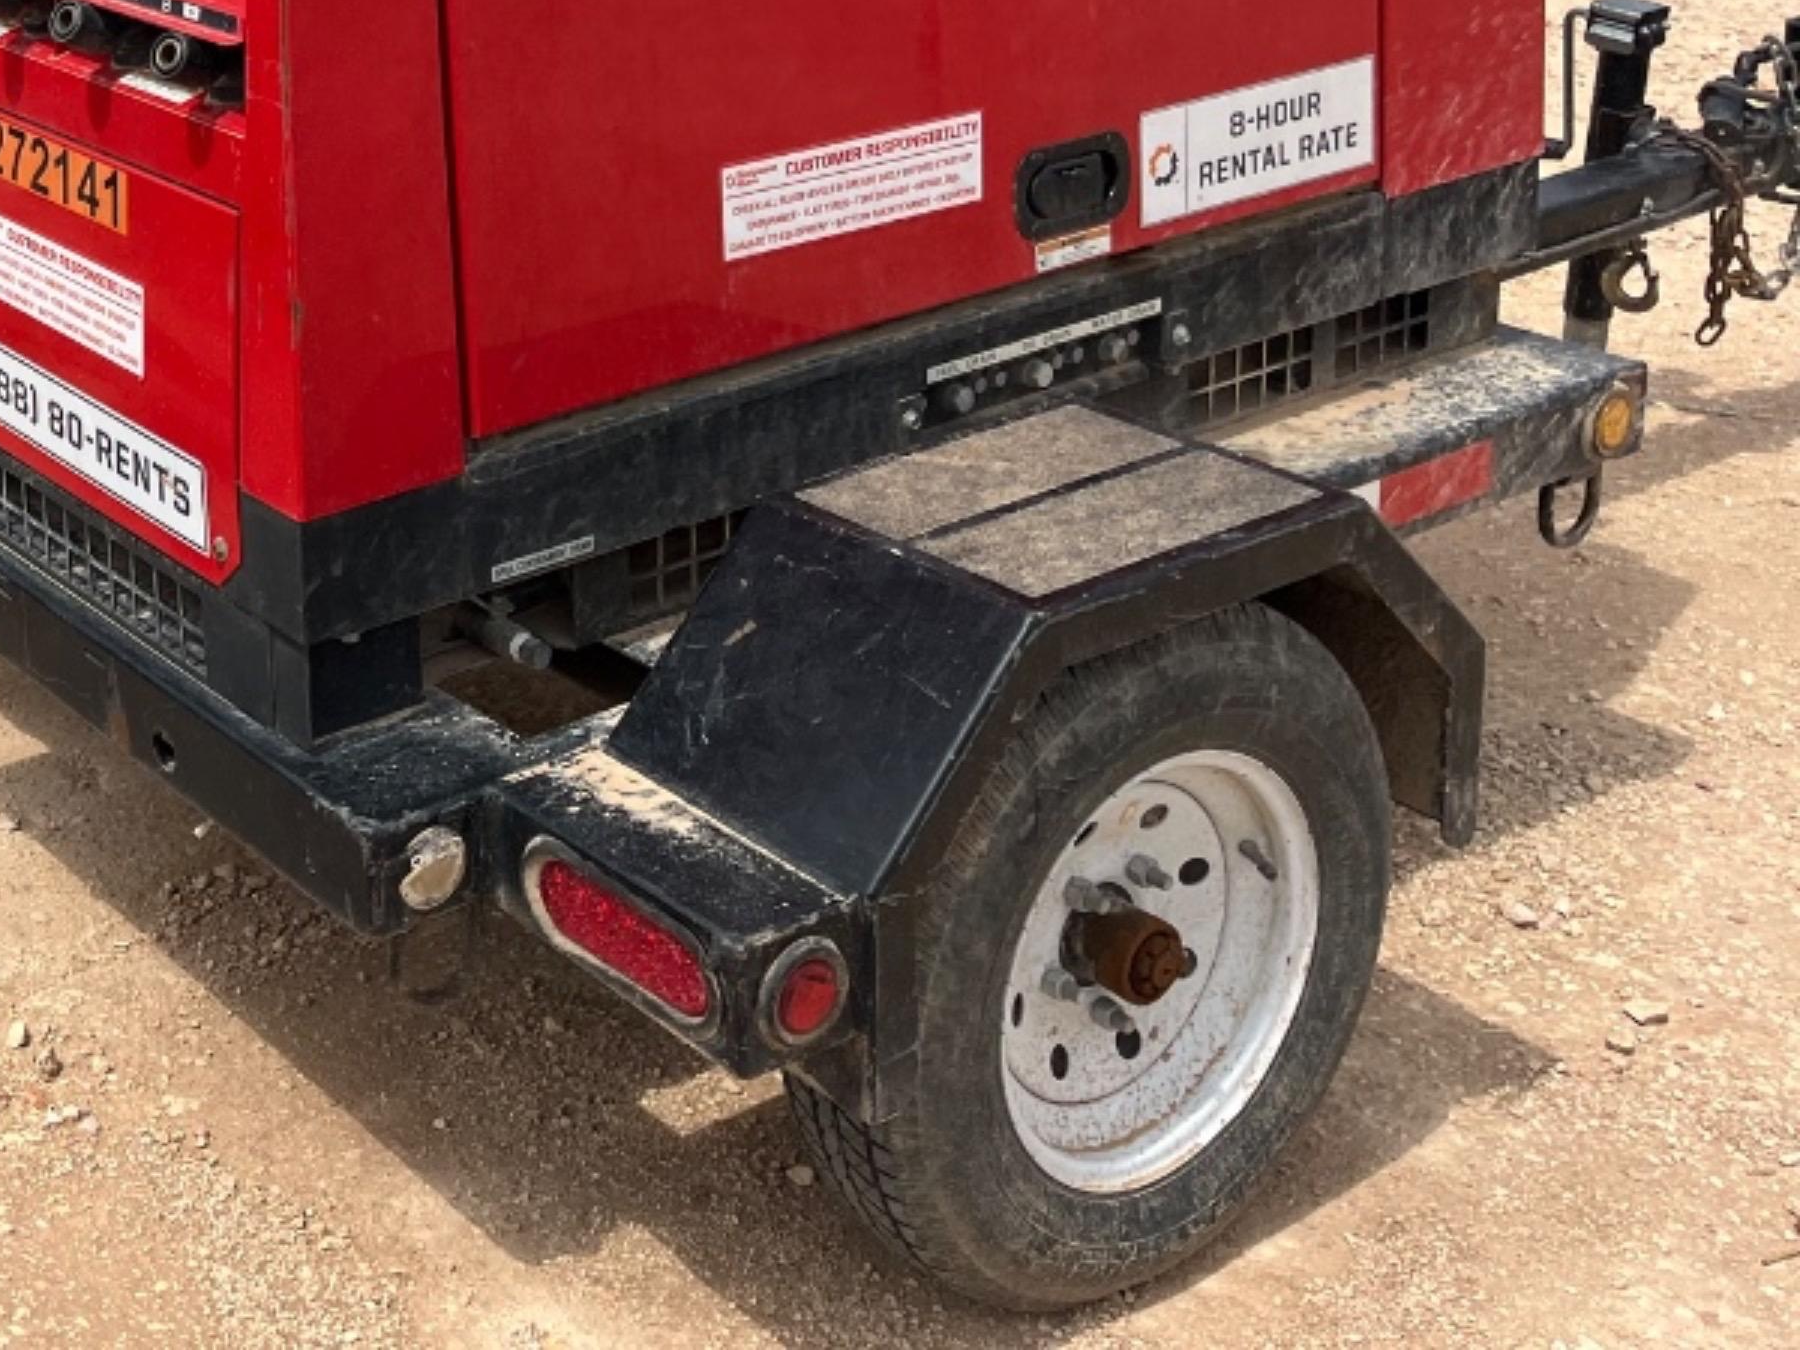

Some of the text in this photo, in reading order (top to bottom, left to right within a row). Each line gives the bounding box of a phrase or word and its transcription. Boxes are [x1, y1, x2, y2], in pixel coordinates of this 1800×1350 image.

[1229, 92, 1321, 138] 8-HOUR
[785, 146, 863, 176] CUSTOMER
[1200, 122, 1358, 190] RENTAL RATE
[47, 400, 192, 518] 80-RENTS
